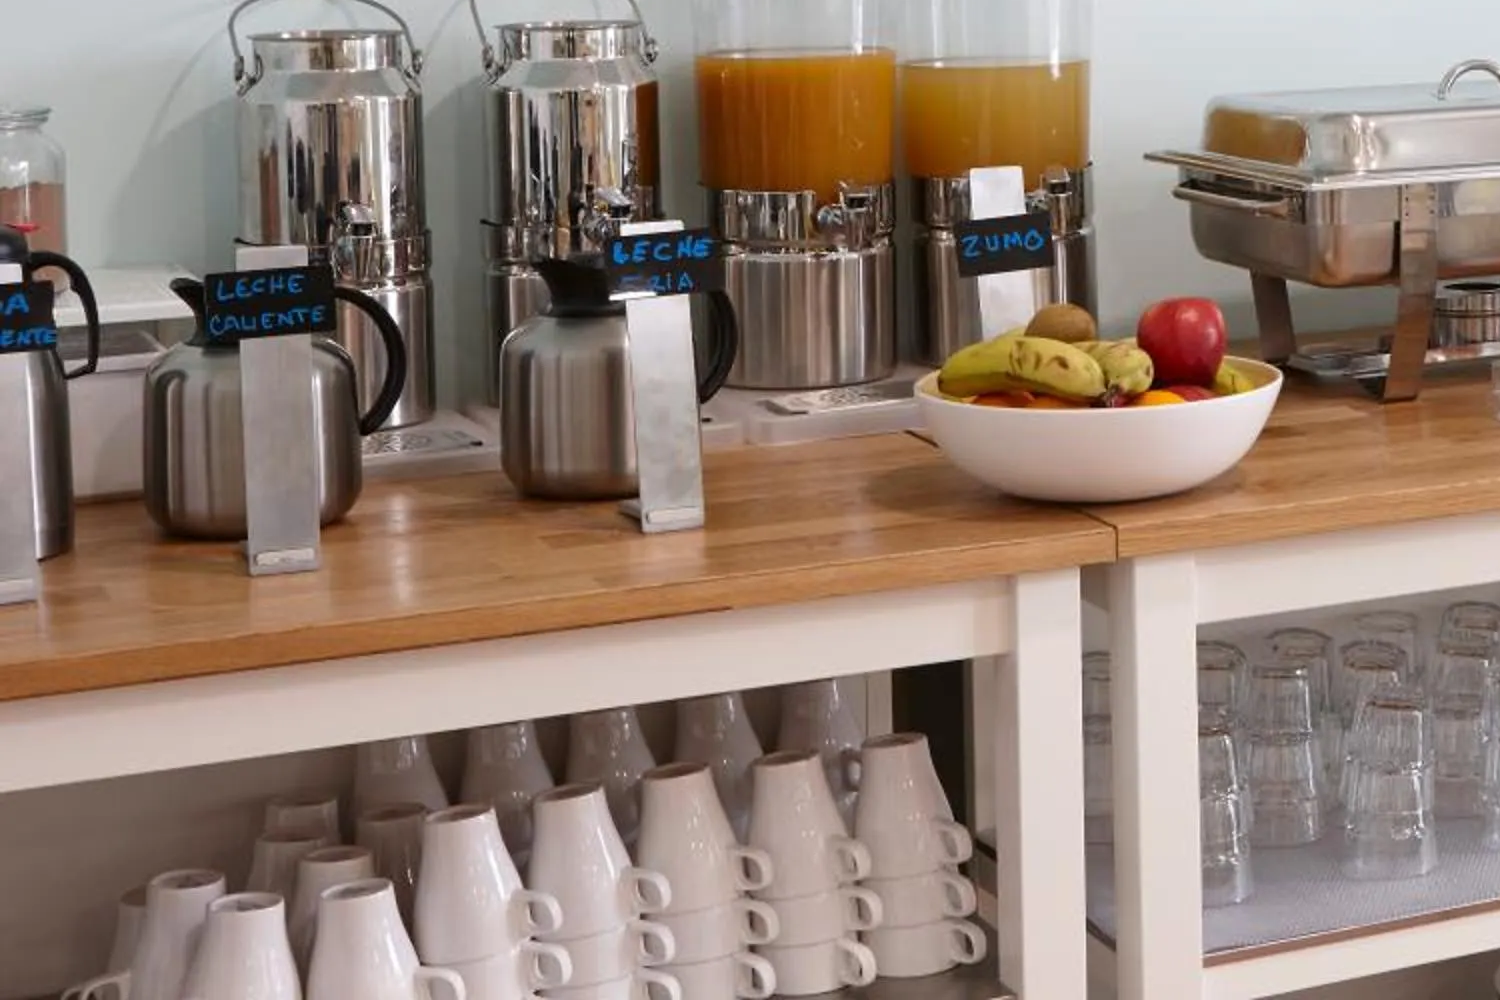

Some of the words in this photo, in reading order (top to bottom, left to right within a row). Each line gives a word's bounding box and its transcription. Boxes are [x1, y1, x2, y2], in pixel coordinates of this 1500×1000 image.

[612, 235, 713, 265] LECHE
[961, 229, 1045, 260] ZUMO
[216, 274, 305, 301] LECHE
[209, 305, 327, 336] CALIENTE
[0, 327, 56, 347] ENTE
